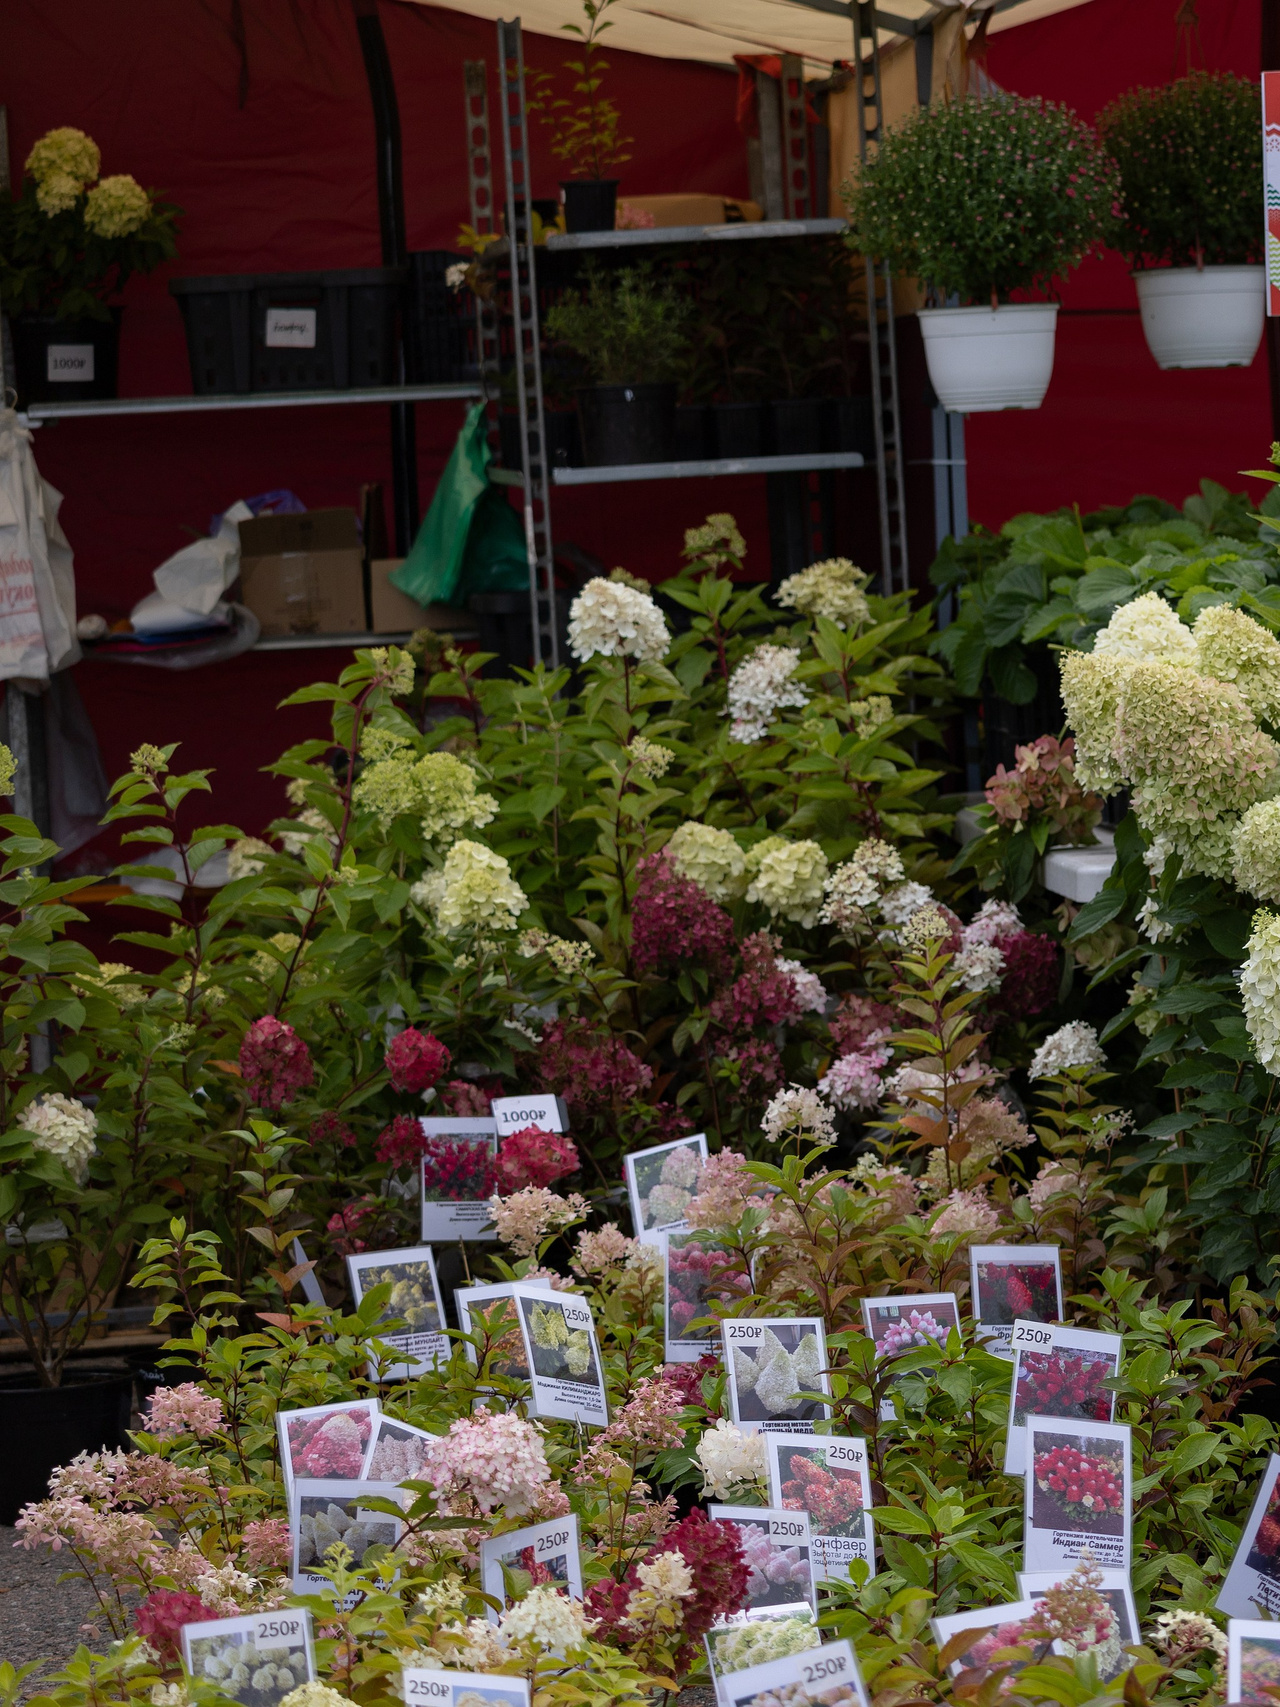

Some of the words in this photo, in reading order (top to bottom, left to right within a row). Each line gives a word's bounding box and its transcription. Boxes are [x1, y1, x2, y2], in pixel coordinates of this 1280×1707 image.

[1053, 1531, 1083, 1539] Гортензия
[1053, 1537, 1086, 1547] Индиан
[1088, 1540, 1124, 1553] Саммер
